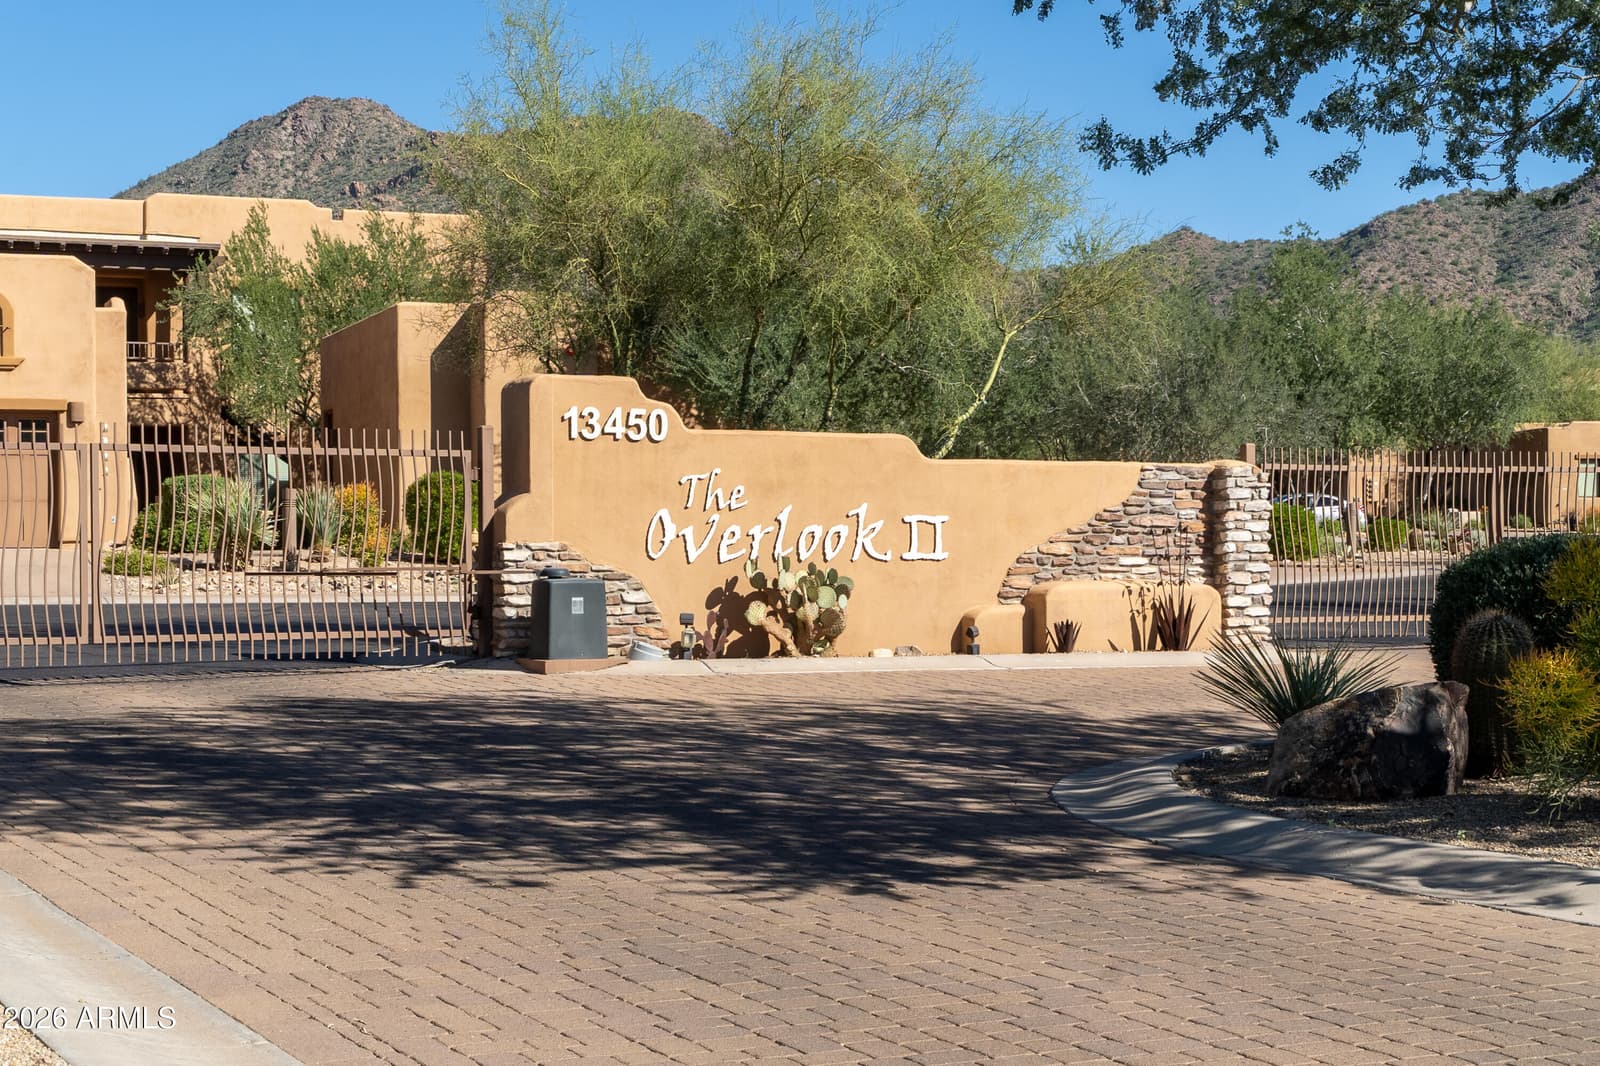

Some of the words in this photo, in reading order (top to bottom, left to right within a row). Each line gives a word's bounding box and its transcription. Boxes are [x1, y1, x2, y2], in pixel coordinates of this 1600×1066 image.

[562, 406, 668, 441] 13450
[680, 468, 748, 511] The
[646, 502, 892, 563] Overlook
[902, 514, 951, 561] II
